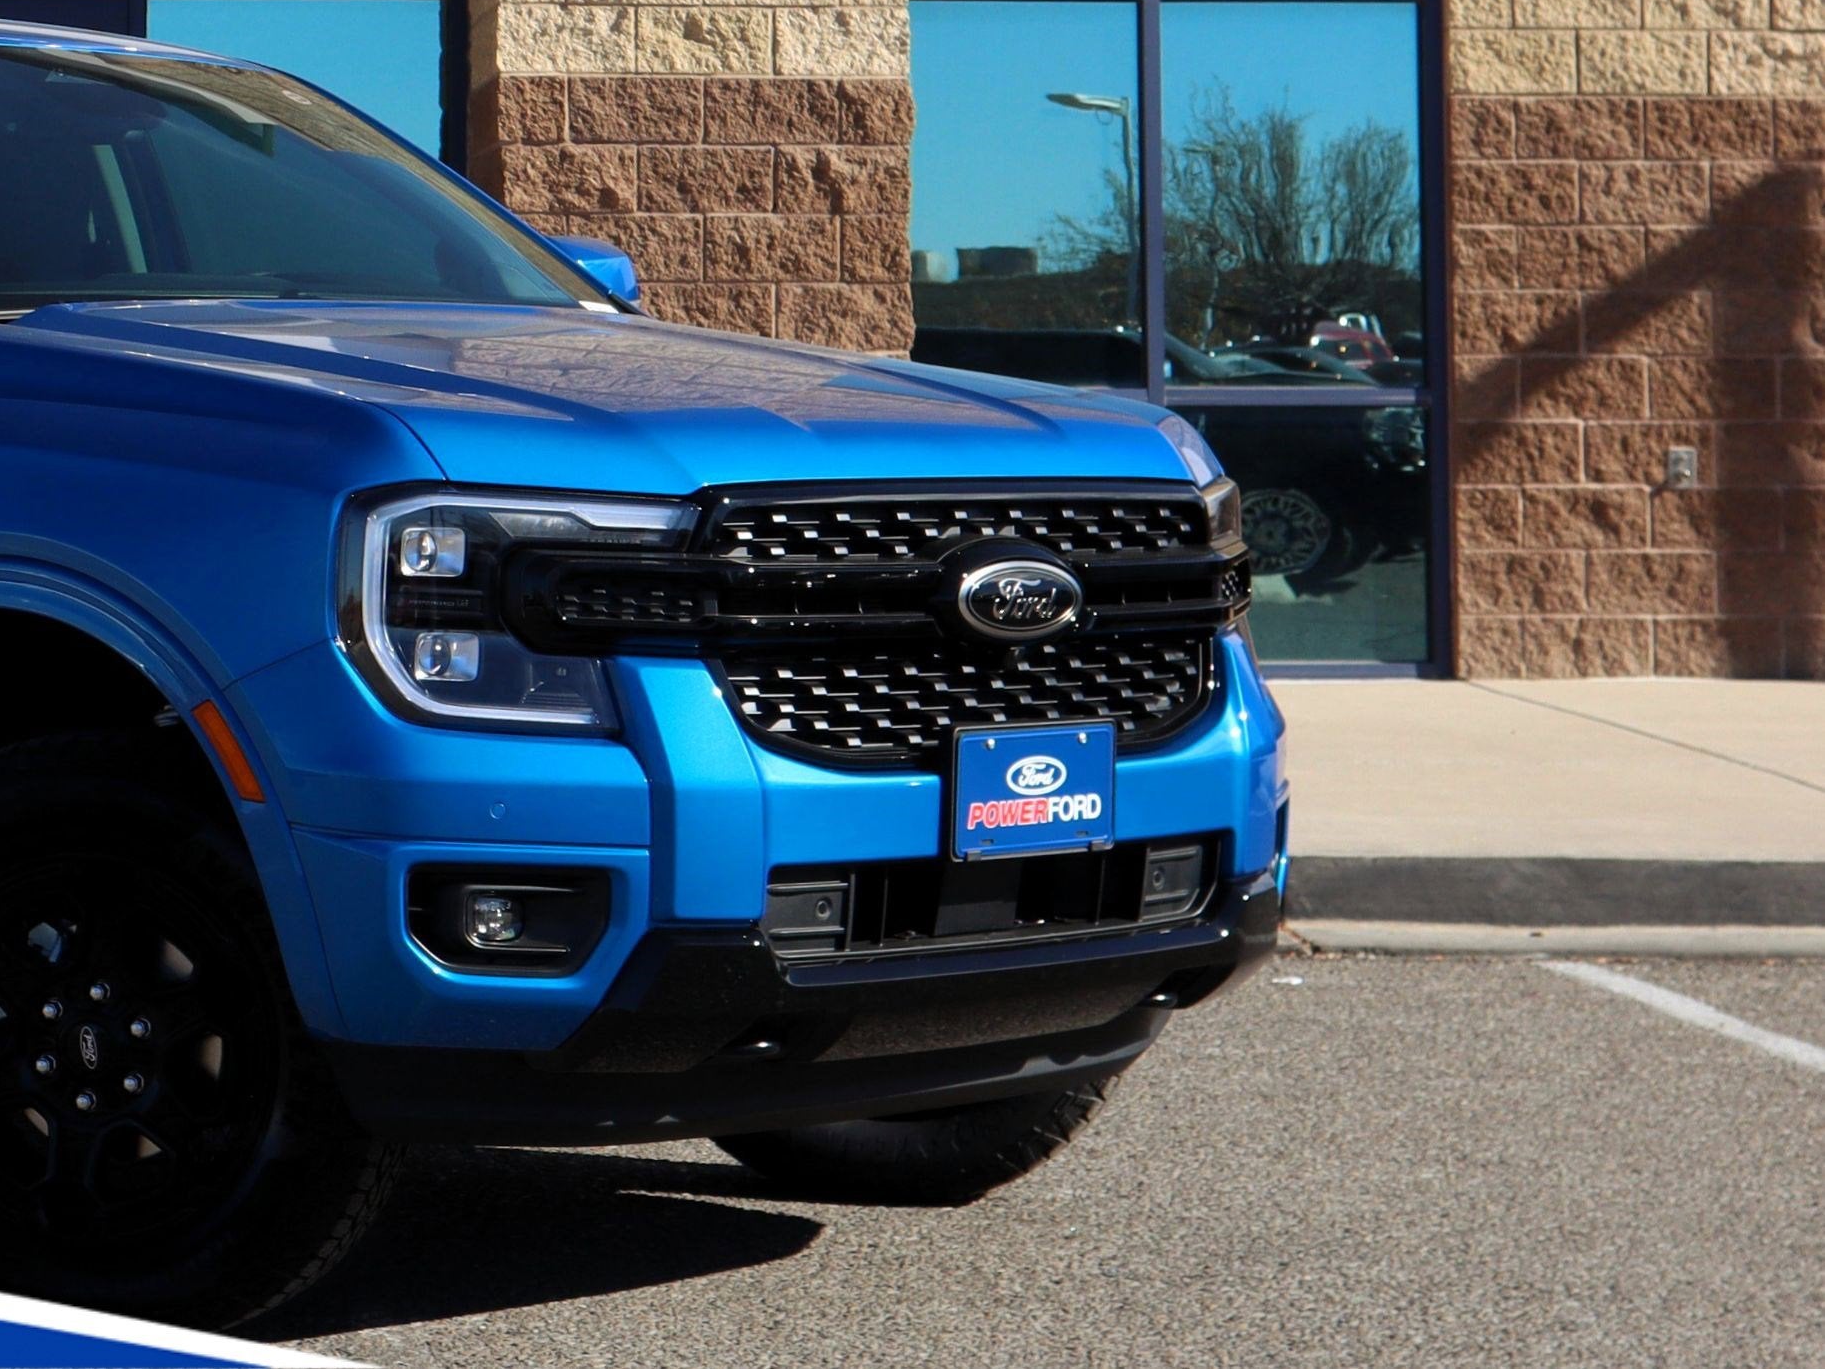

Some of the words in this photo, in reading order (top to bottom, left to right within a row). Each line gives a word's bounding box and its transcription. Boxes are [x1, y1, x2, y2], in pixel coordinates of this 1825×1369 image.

[993, 577, 1057, 621] Ford
[1018, 762, 1055, 787] Ford
[967, 792, 1102, 830] POWERFORD
